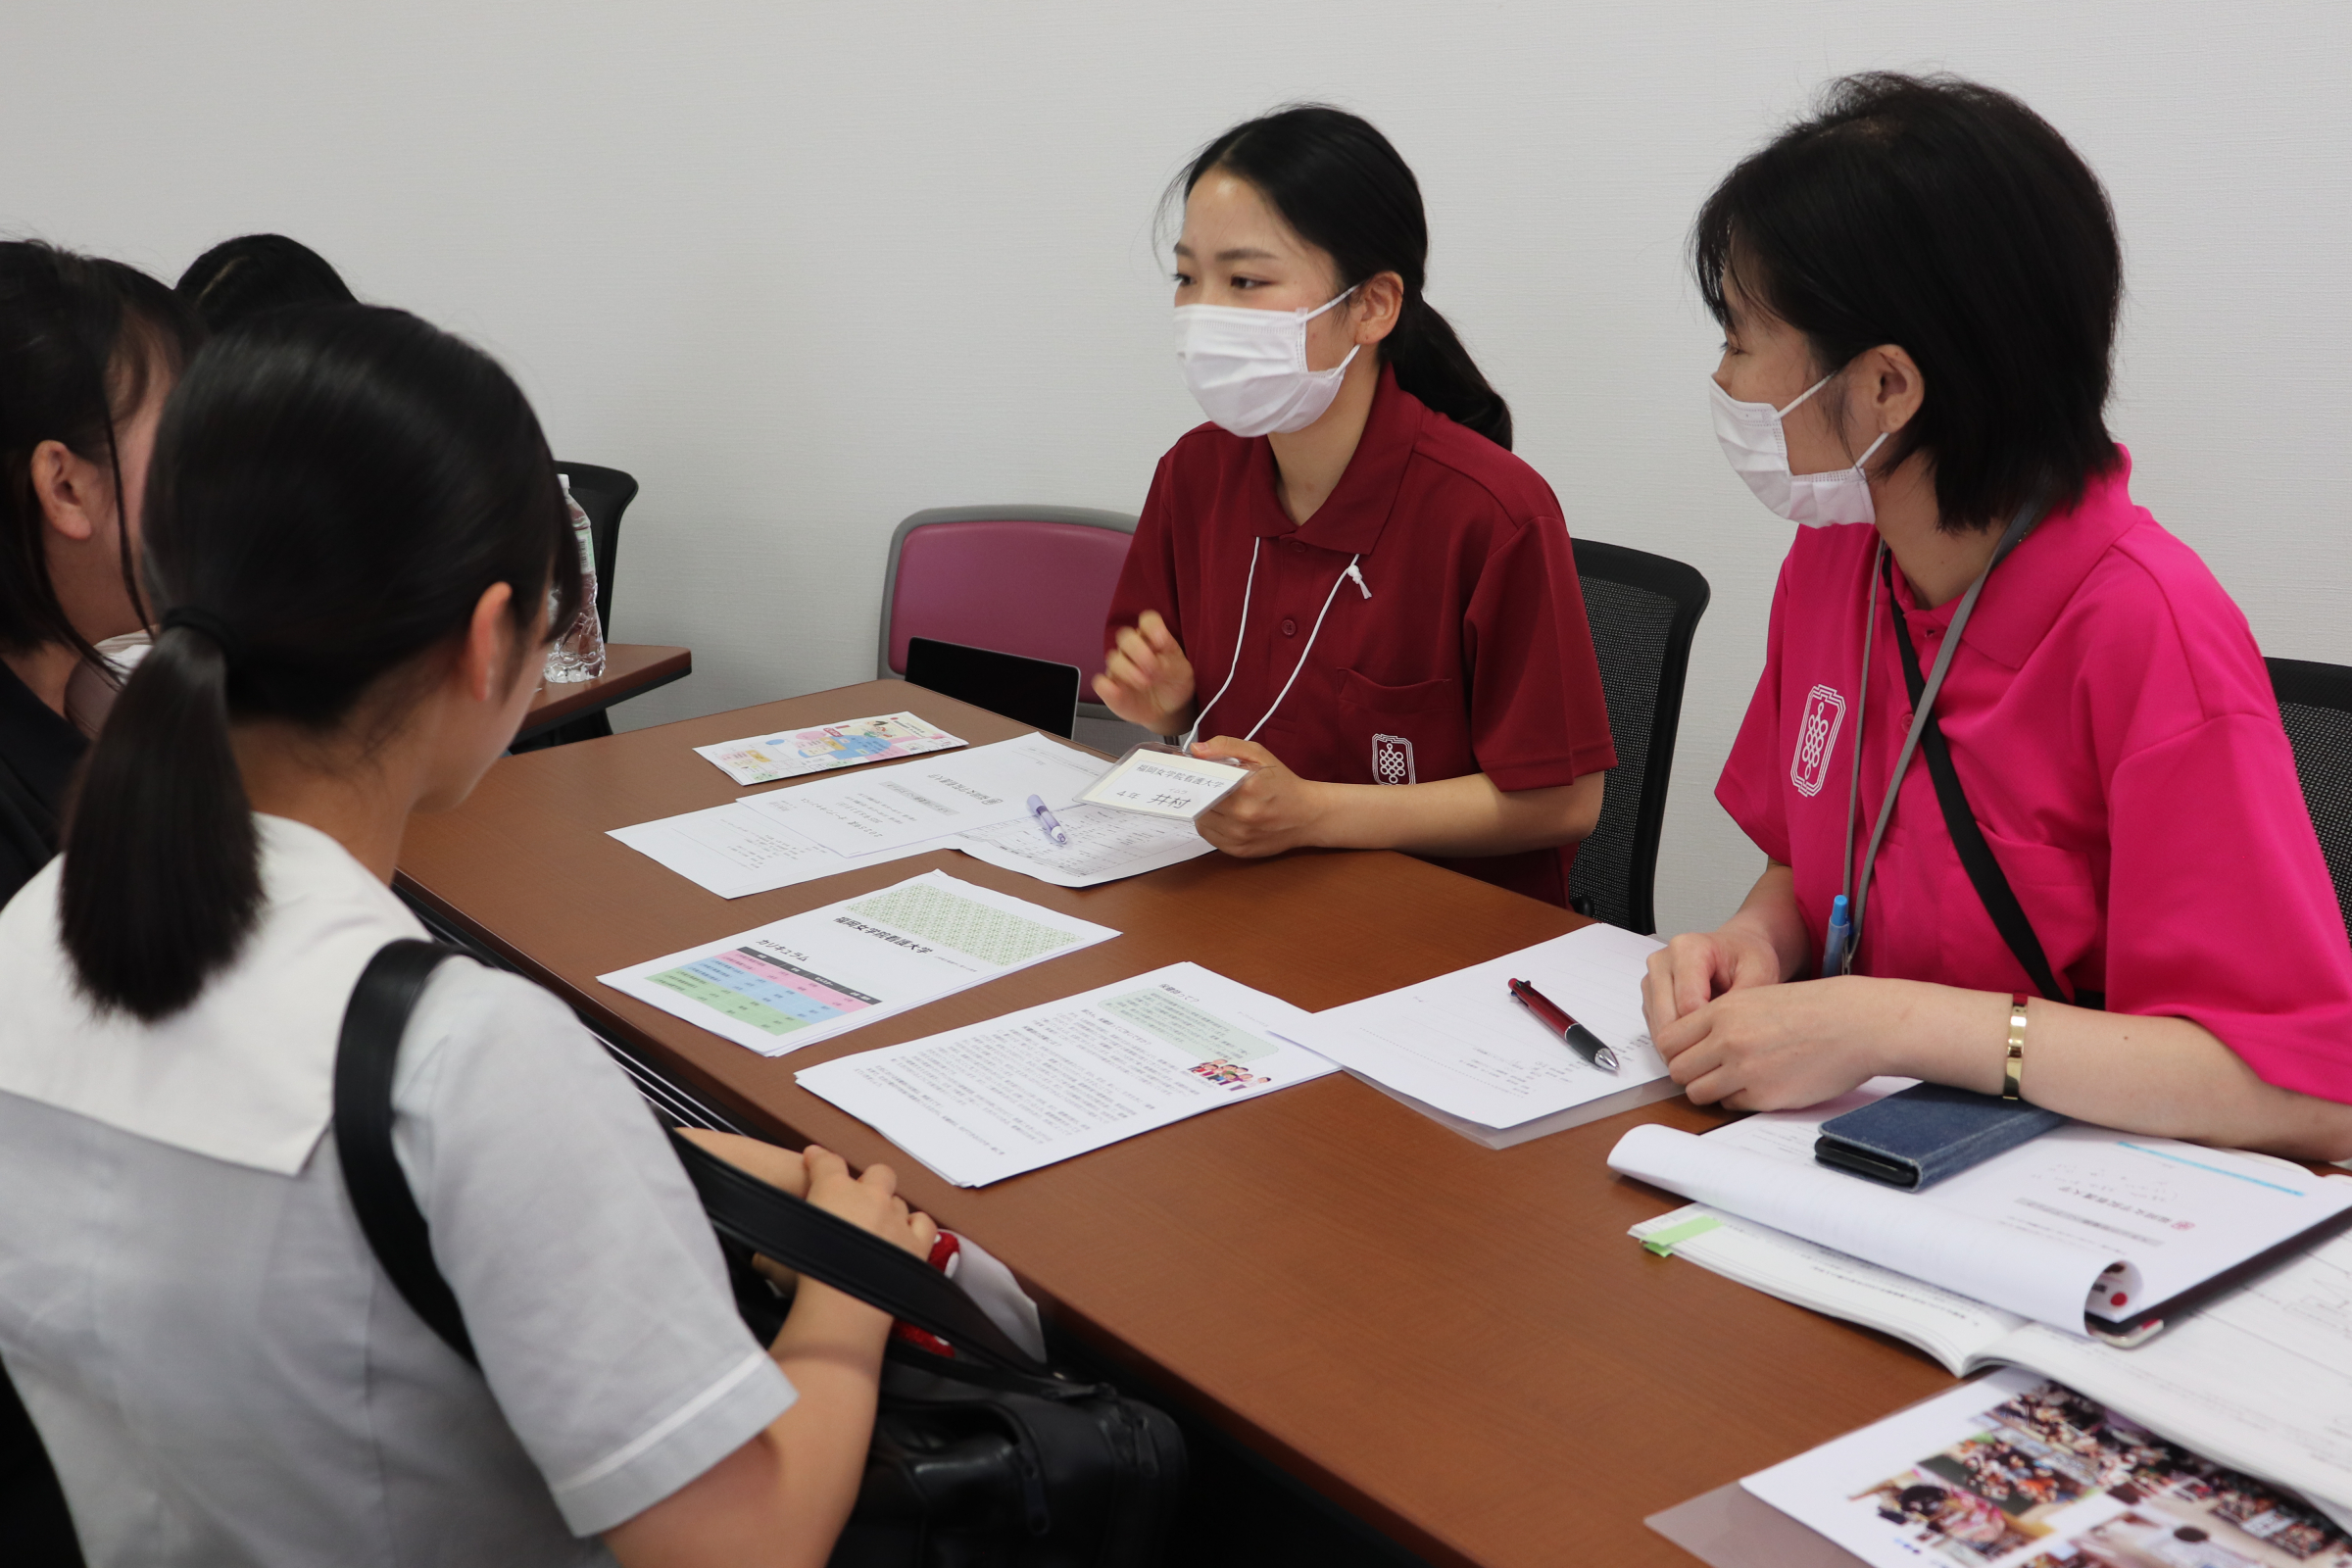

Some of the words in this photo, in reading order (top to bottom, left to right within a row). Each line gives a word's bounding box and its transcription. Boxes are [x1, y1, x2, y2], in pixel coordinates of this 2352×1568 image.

[1136, 763, 1225, 789] 福岡女学院看護大学
[1147, 793, 1192, 808] 井村
[833, 916, 933, 954] 福岡女学院看護大学
[756, 939, 810, 962] カリキュラム
